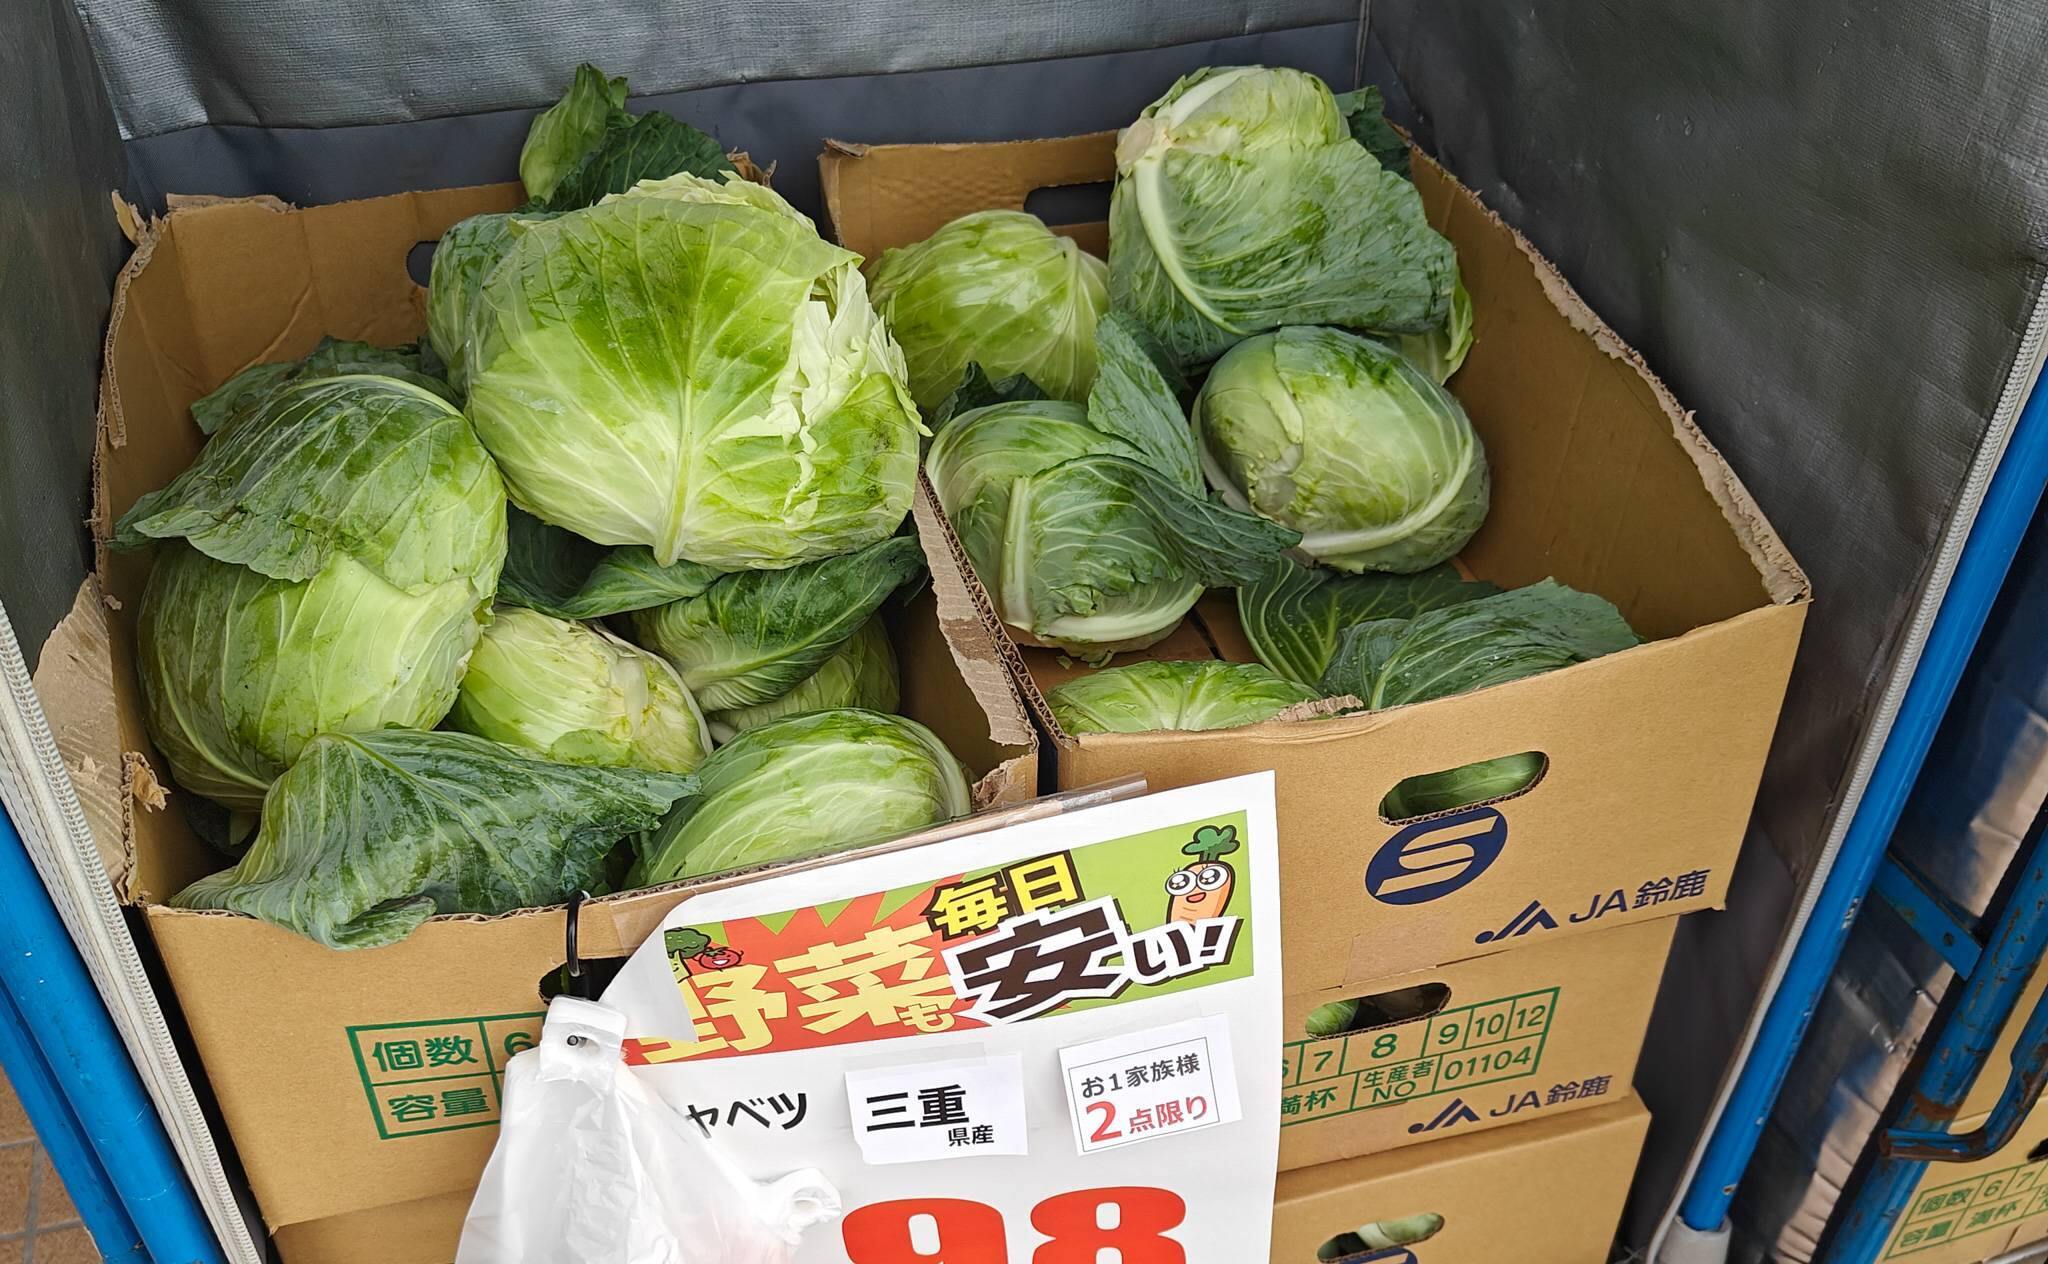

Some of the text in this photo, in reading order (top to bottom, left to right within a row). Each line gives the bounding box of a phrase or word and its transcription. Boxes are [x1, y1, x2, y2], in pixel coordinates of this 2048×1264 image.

[929, 851, 1080, 936] 毎日
[372, 1035, 479, 1072] 個数
[1313, 1049, 1334, 1073] 7
[1371, 1033, 1398, 1059] 8
[1438, 1022, 1460, 1045] 9
[1475, 1013, 1505, 1038] 10
[1515, 1004, 1546, 1030] 12
[1080, 1052, 1201, 1099] お1家族様
[1362, 1058, 1435, 1090] 生産者
[1444, 1046, 1532, 1080] 01104
[388, 1087, 492, 1123] 容量
[865, 1083, 970, 1133] 三重
[1372, 1080, 1417, 1103] NO
[947, 1124, 996, 1148] 県産
[1085, 1095, 1208, 1144] 2点限り
